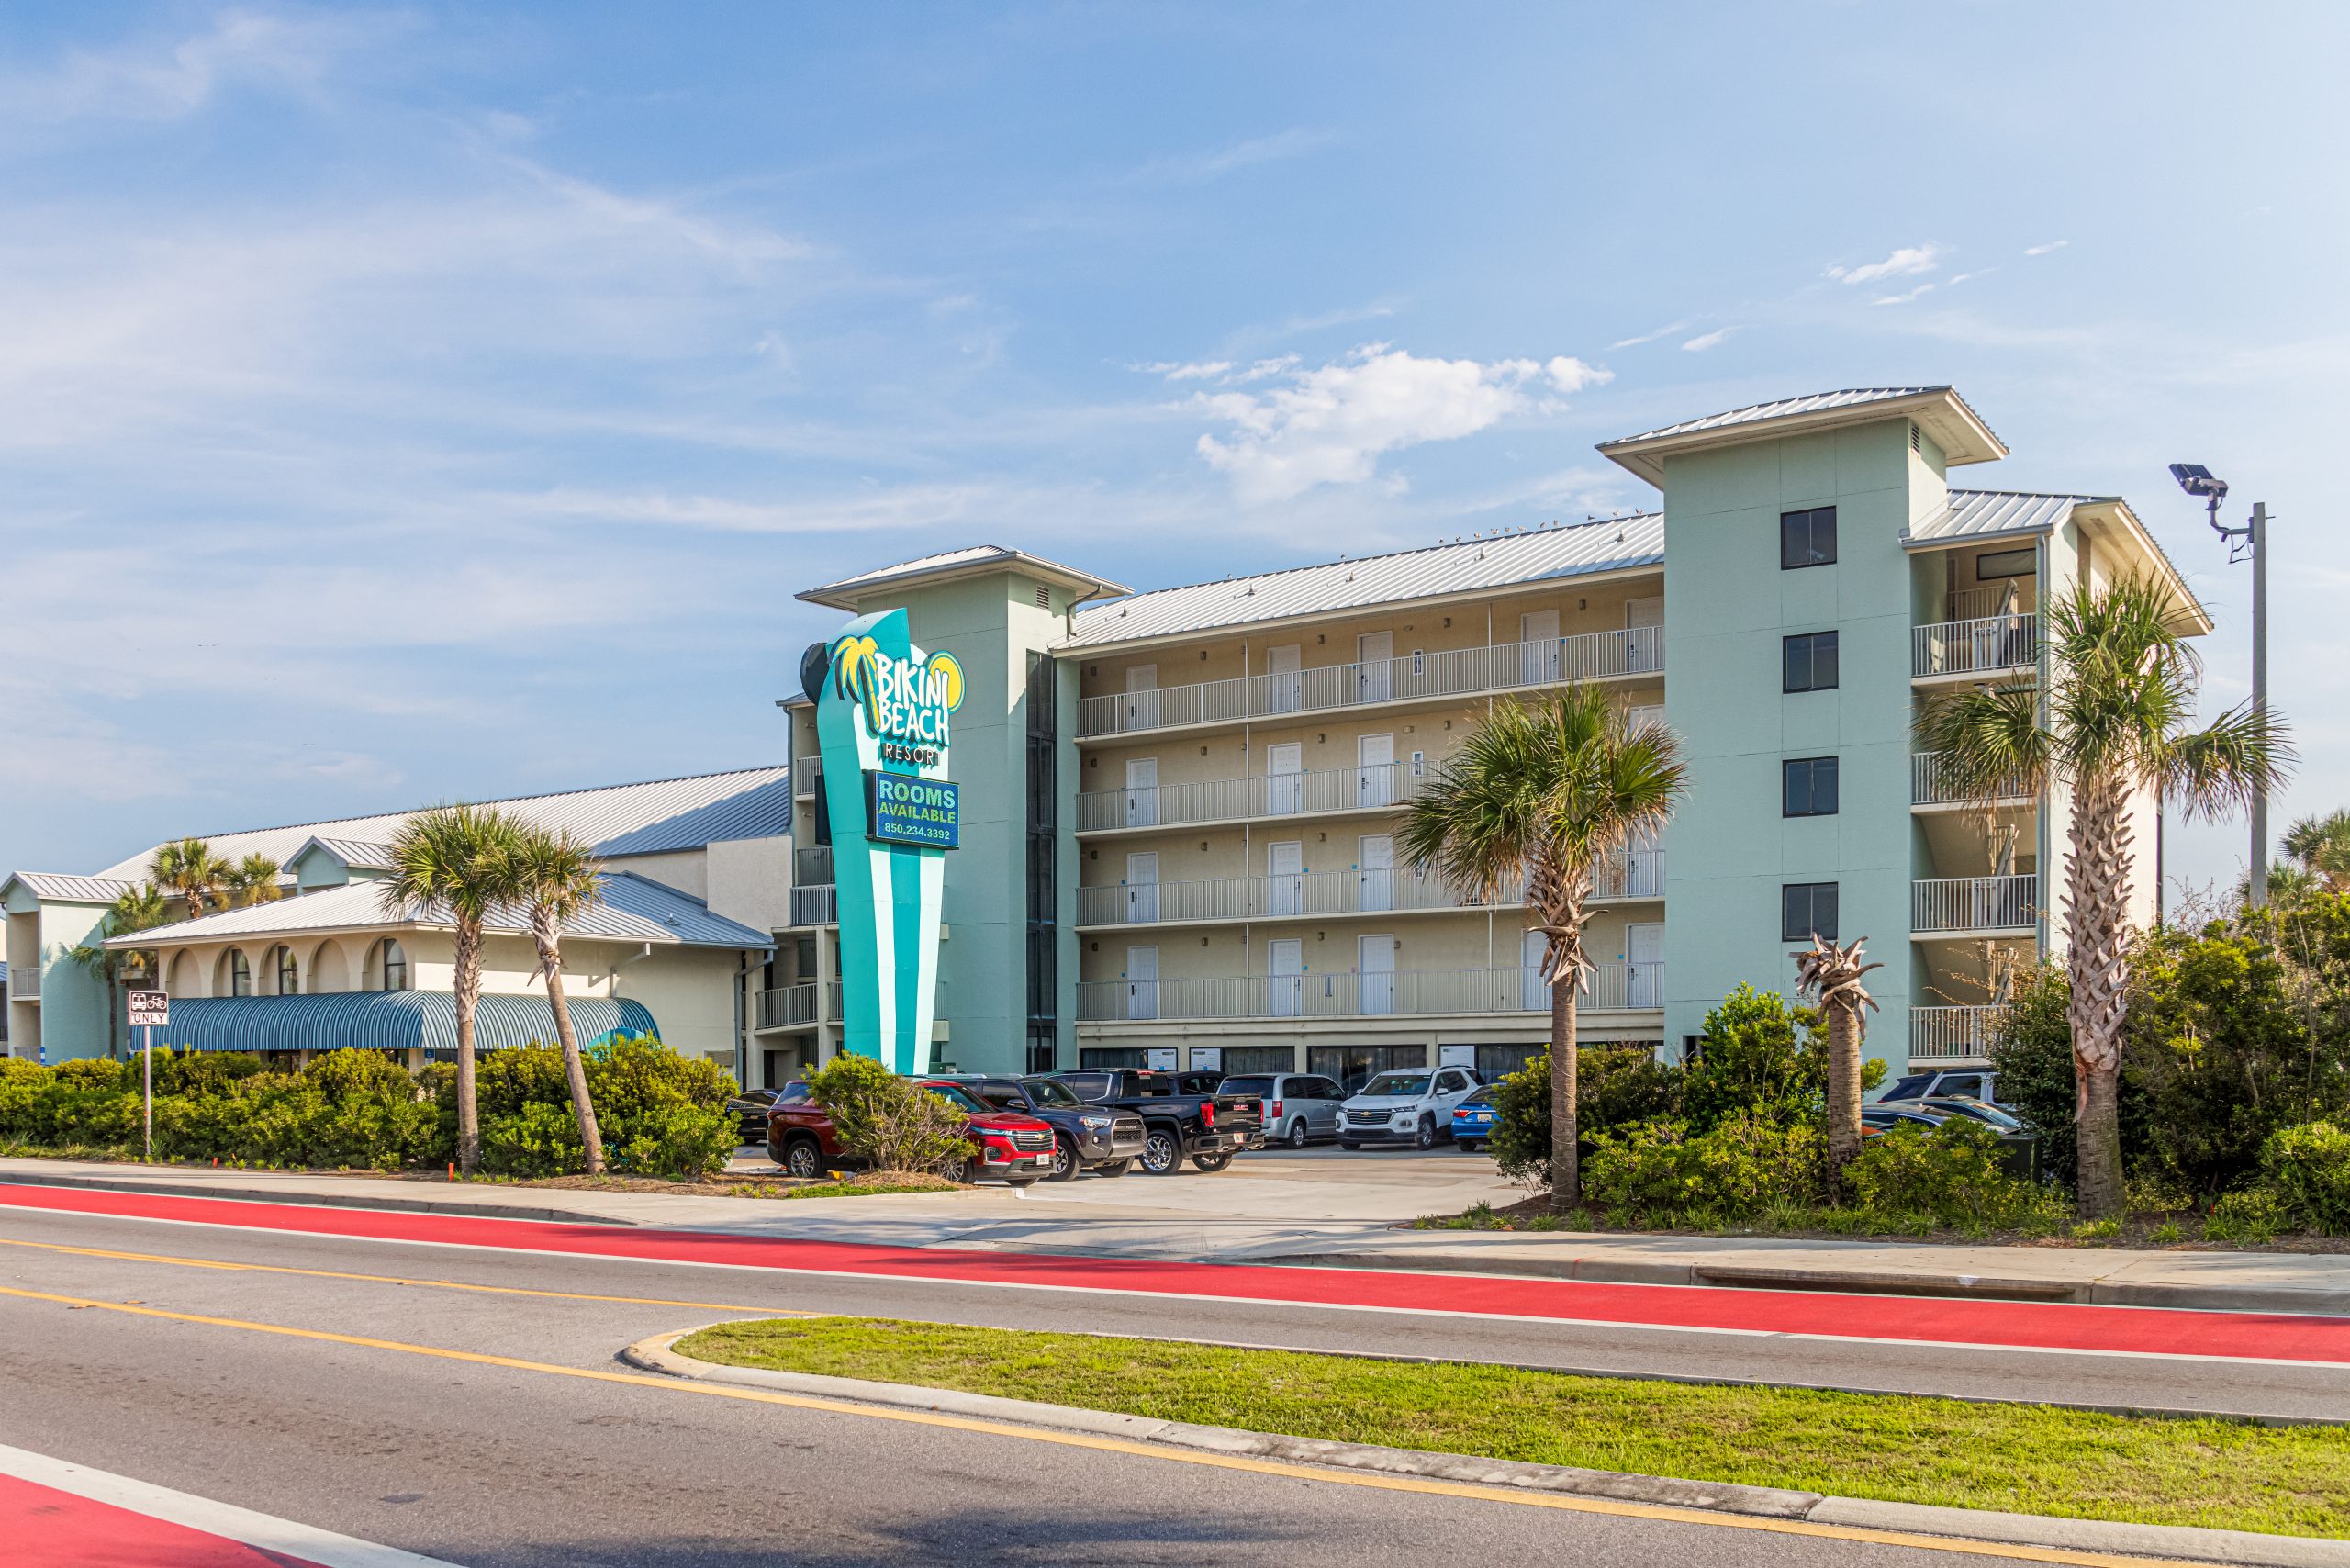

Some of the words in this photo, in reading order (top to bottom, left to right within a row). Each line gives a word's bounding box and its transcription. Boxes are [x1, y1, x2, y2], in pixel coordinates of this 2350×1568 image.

[874, 653, 949, 715] BIKINI
[878, 697, 949, 744] BEACH
[884, 743, 942, 766] RESORT
[879, 779, 956, 809] ROOMS
[878, 801, 956, 824] AVAILABLE
[884, 823, 950, 840] 850.234.3392
[134, 1013, 164, 1024] ONLY
